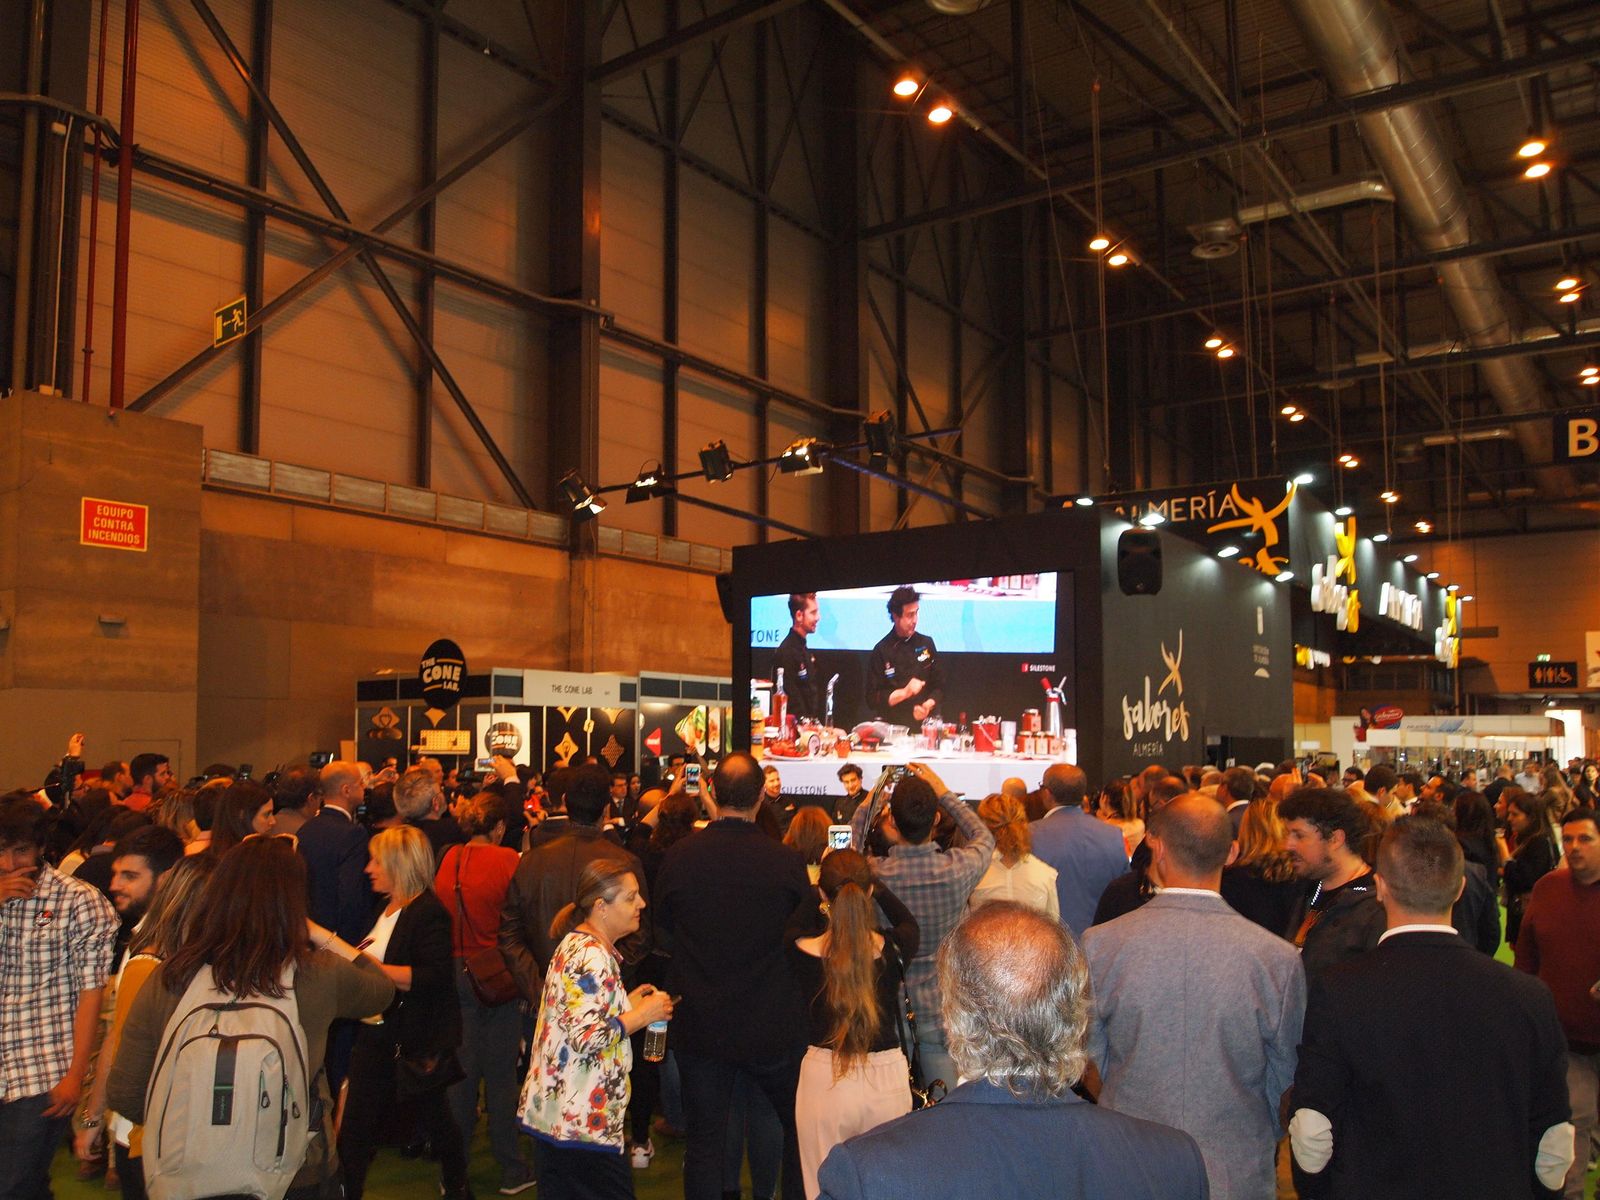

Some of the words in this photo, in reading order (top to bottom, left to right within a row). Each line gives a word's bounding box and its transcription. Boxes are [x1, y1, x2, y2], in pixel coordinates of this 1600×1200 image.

[1568, 418, 1599, 457] B
[96, 504, 134, 519] EQUIPO
[93, 516, 135, 532] CONTRA
[88, 529, 140, 545] INCENDIOS
[423, 665, 462, 683] CONE
[552, 684, 562, 694] THE
[564, 685, 580, 695] CONE
[582, 686, 593, 696] LAB
